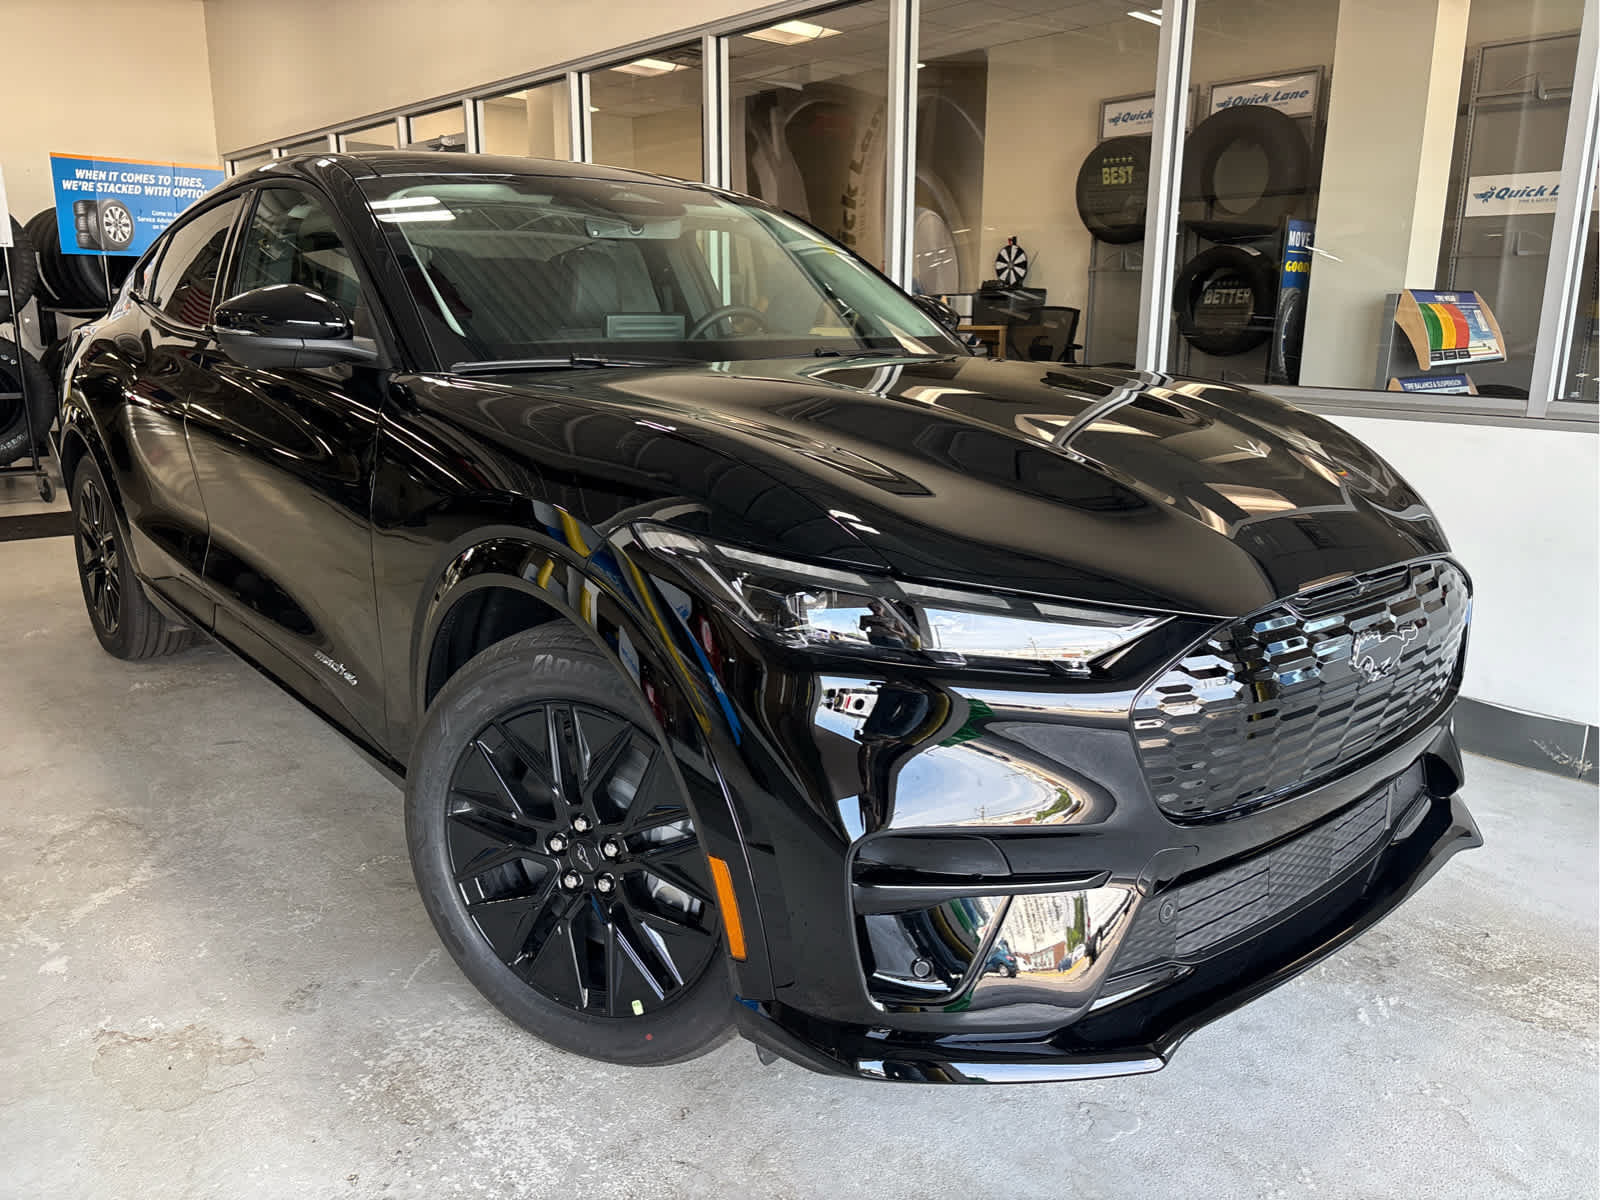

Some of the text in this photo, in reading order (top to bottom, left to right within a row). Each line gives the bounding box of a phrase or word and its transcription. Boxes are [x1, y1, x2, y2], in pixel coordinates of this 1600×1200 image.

[1232, 93, 1273, 107] Quick
[1273, 88, 1309, 101] Lane
[1122, 109, 1154, 123] Quick
[75, 168, 206, 189] WHEN IT COMES TO TIRES,
[1102, 165, 1135, 185] BEST
[62, 179, 95, 192] WE'RE
[96, 182, 142, 195] STACKED
[144, 185, 171, 197] WITH
[1495, 184, 1549, 200] Quick
[1288, 231, 1312, 247] MOVE
[1203, 288, 1252, 304] BETTER
